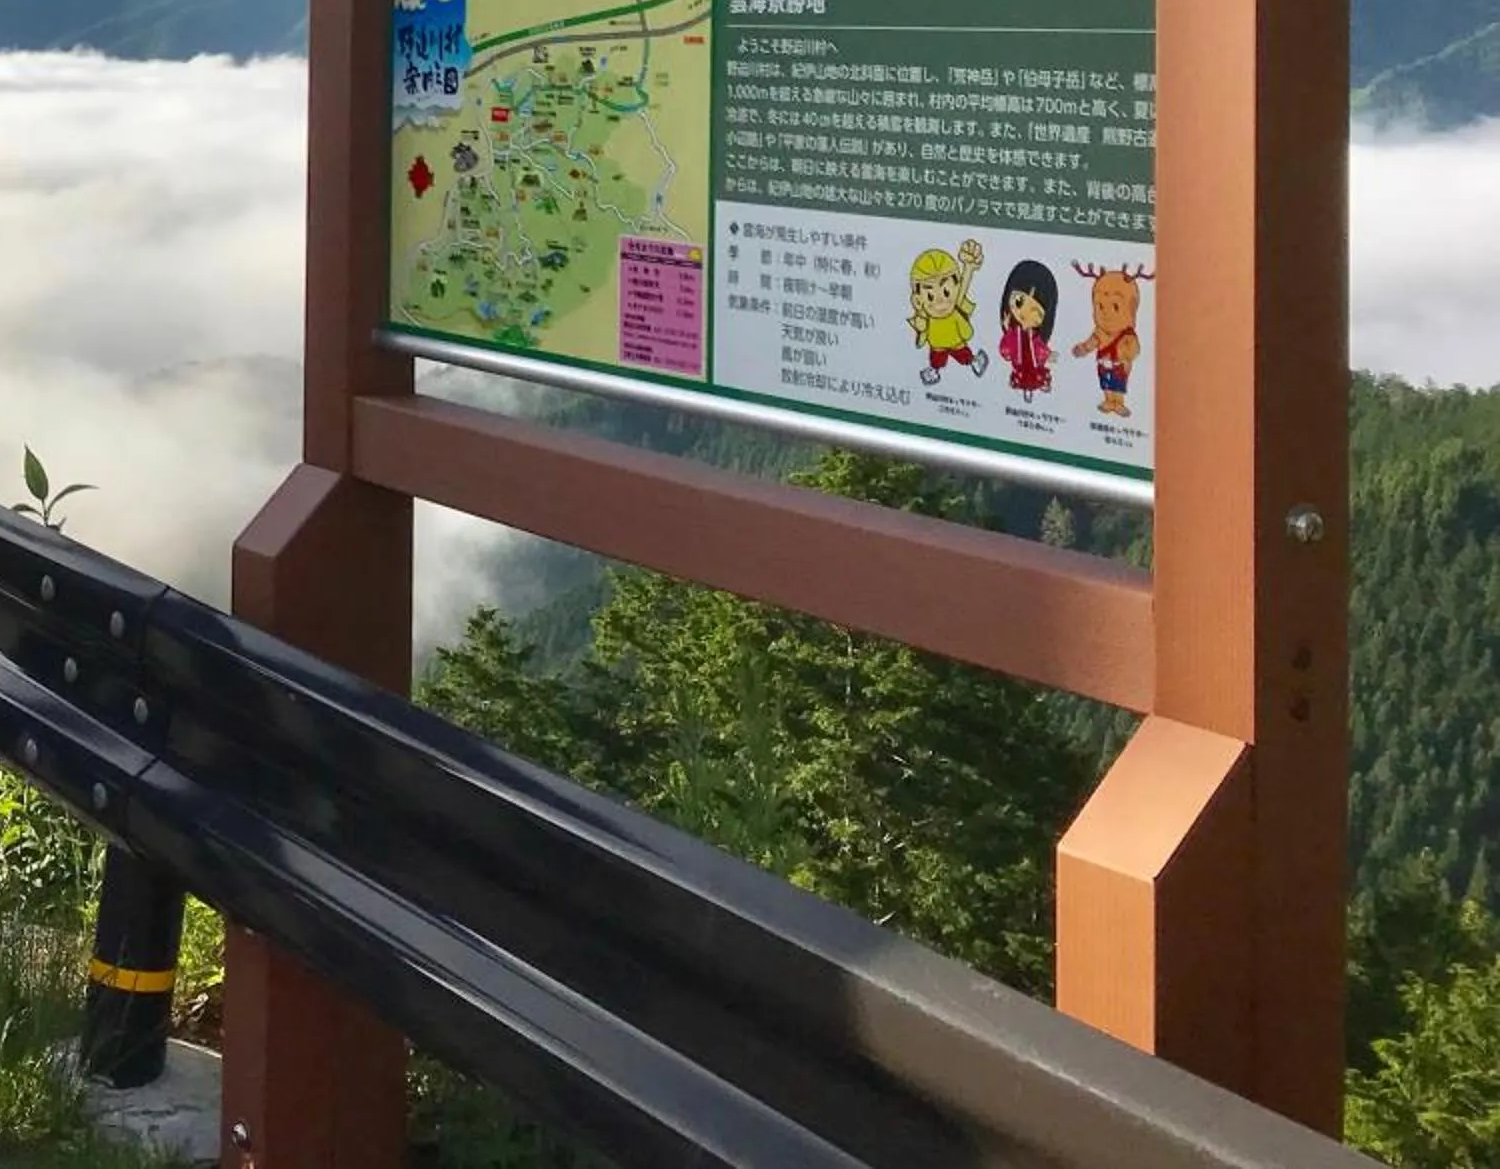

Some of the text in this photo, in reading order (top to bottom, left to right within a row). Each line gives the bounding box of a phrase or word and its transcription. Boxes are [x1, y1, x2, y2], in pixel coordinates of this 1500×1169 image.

[738, 38, 839, 56] ようこそ野迫川村へ
